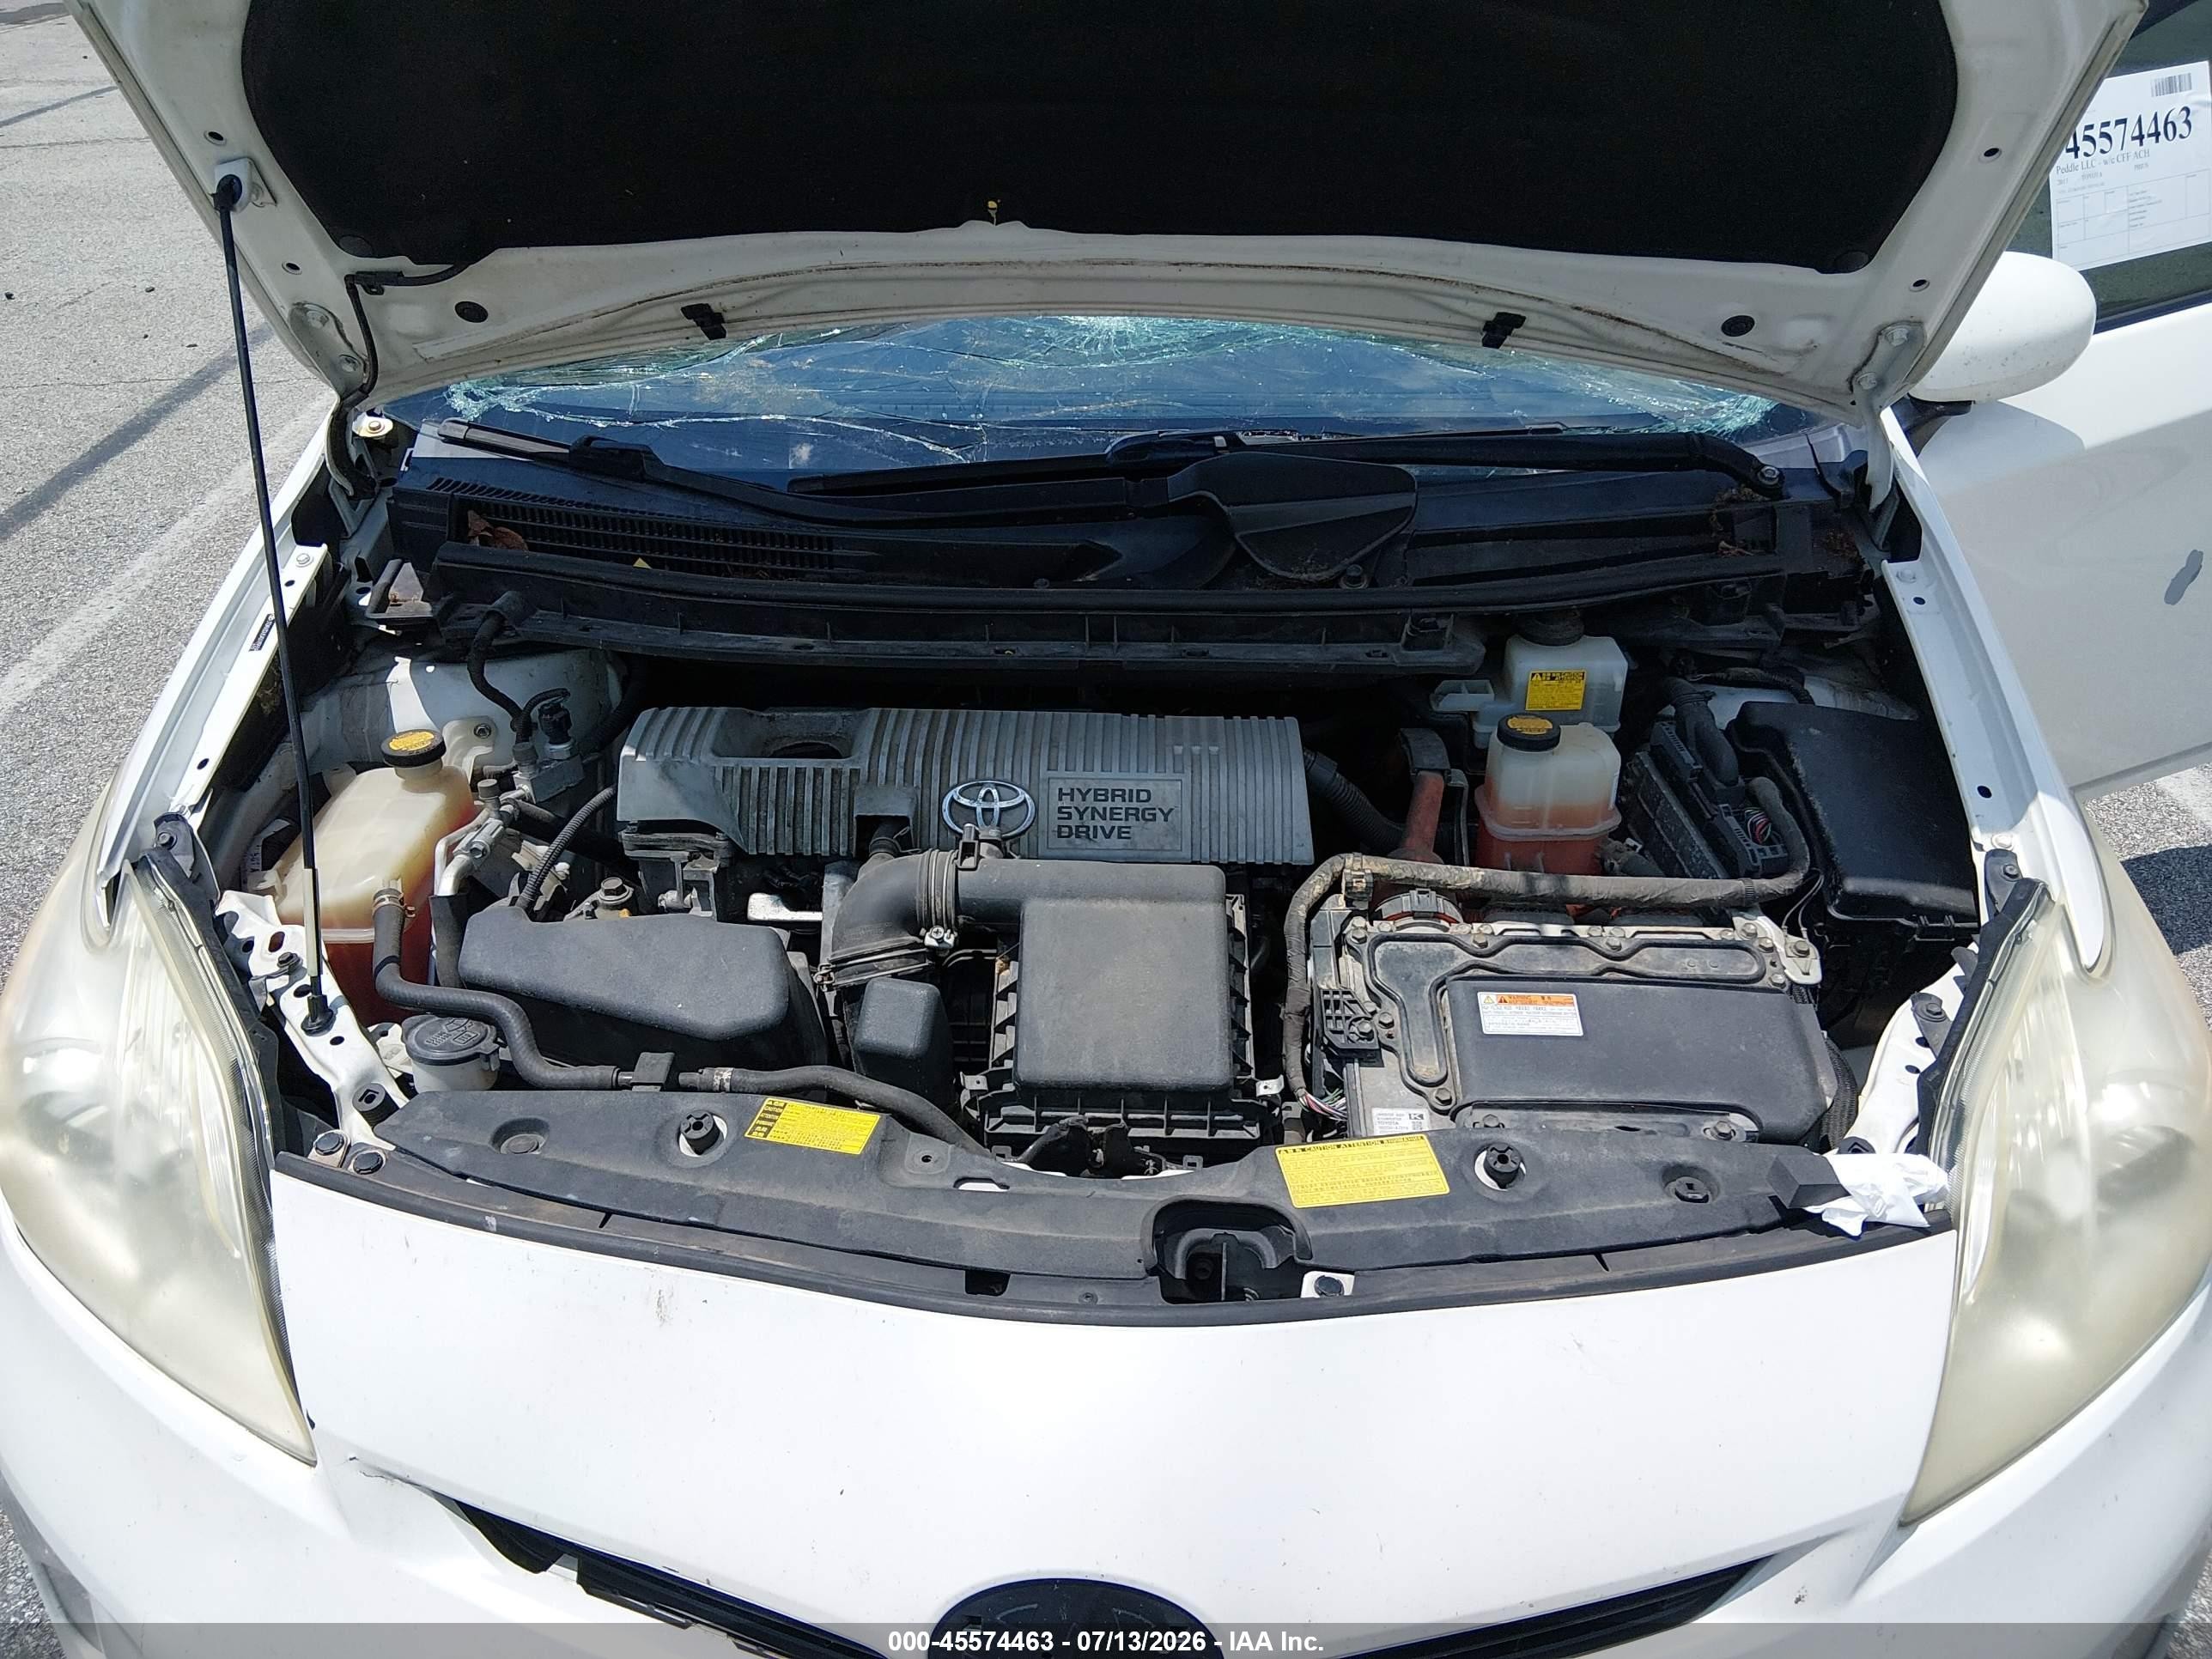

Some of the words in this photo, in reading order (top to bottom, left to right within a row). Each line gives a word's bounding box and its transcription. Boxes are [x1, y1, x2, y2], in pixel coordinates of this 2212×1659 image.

[2056, 163, 2079, 174] Peddle
[2081, 158, 2096, 170] LLC
[2116, 152, 2131, 165] CFF
[2133, 149, 2150, 160] ACH
[1057, 787, 1152, 803] HYBRID
[1057, 806, 1175, 822] SYNERGY
[1057, 824, 1132, 840] DRIVE
[1340, 1139, 1382, 1149] ATTENTION
